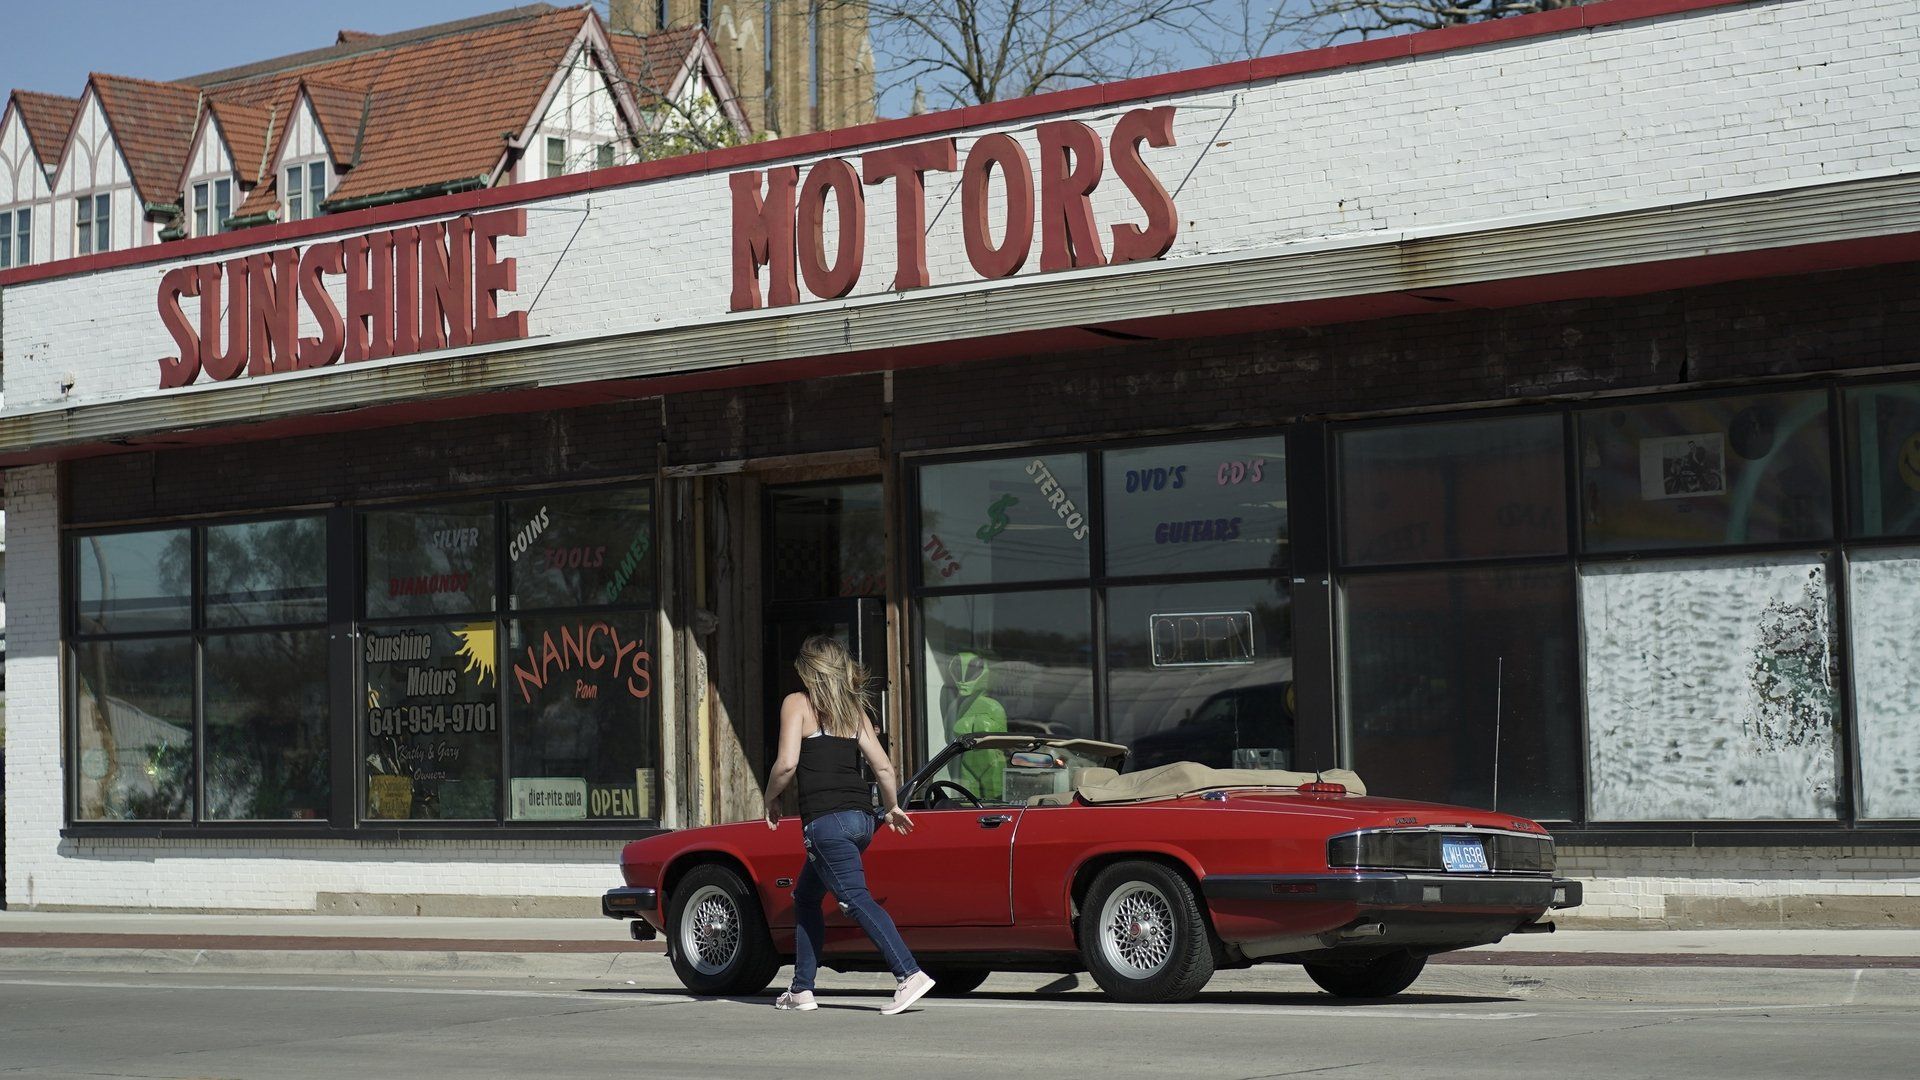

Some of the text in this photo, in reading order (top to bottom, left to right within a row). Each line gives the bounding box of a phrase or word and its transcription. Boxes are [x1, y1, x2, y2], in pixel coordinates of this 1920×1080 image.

[158, 106, 1177, 390] SUNSHINE MOTORS
[1126, 459, 1265, 493] DVD'S CD'S
[1026, 459, 1089, 542] STEREOS
[433, 527, 479, 549] SILVER
[509, 505, 550, 562] COINS
[1155, 517, 1241, 544] GUITARS
[545, 544, 607, 571] TOOLS
[606, 524, 650, 602] GAMES
[923, 534, 960, 578] TV'S
[389, 571, 470, 598] DIAMONDS
[365, 629, 432, 663] Sunshine
[1154, 617, 1250, 663] OPEN
[513, 620, 653, 704] NANCY'S
[406, 666, 457, 697] Motors
[575, 679, 598, 700] Pawn
[369, 703, 496, 737] 641-954-9701
[437, 741, 460, 762] Gary
[591, 788, 634, 817] OPEN
[1463, 846, 1484, 863] 698
